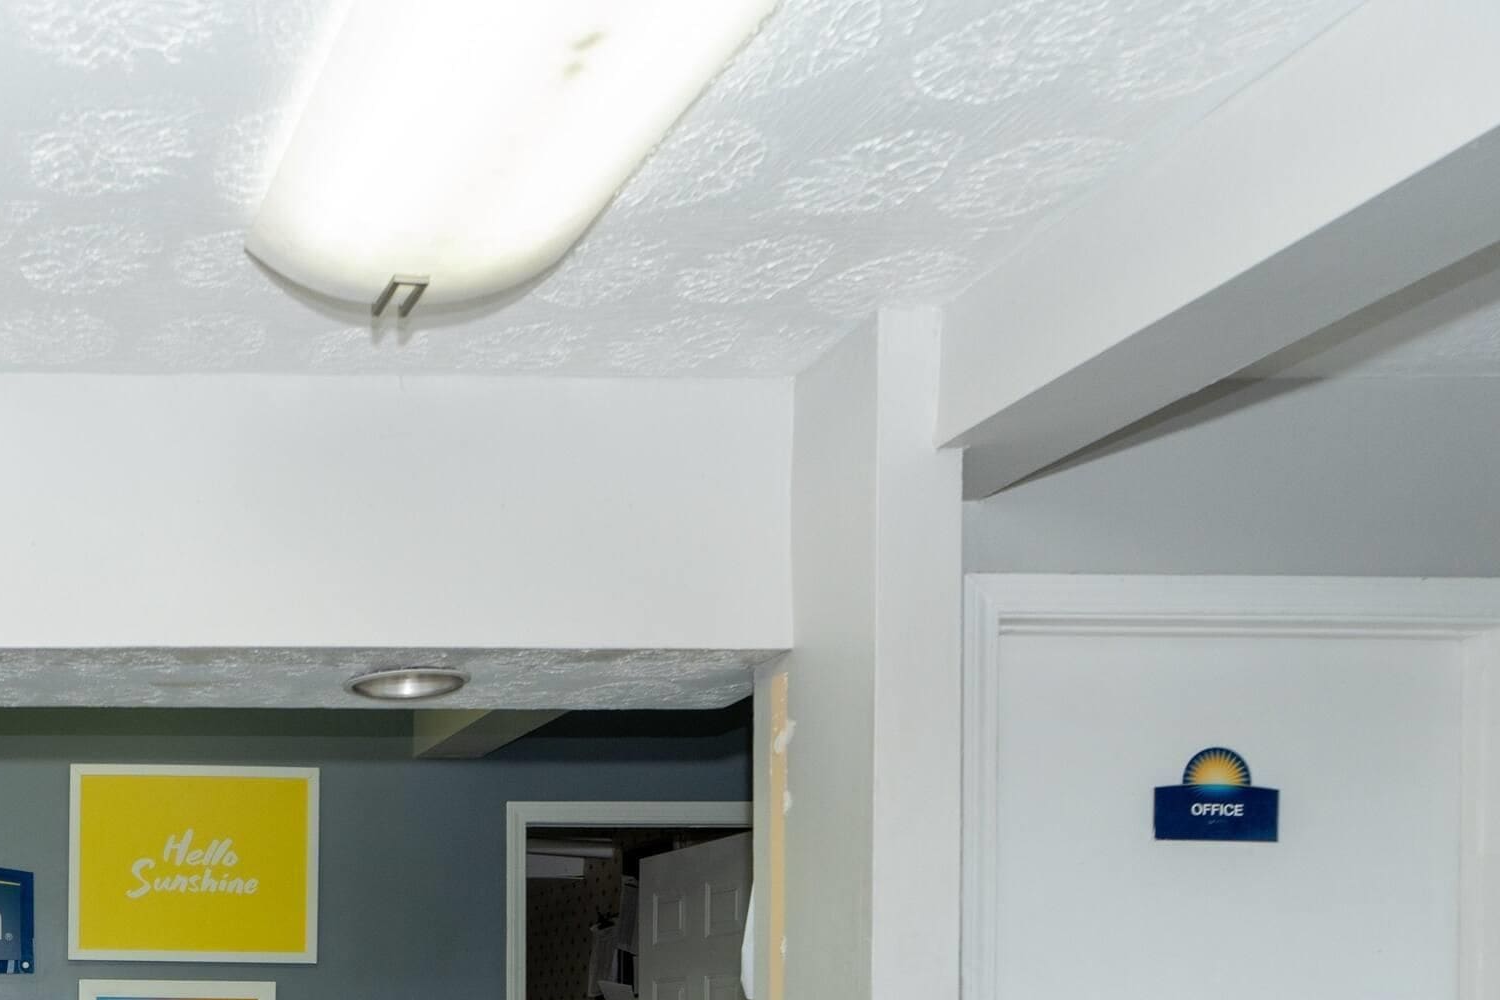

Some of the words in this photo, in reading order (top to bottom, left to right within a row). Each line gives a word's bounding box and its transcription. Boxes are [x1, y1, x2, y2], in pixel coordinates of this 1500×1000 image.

[1191, 802, 1245, 817] OFFICE
[164, 827, 239, 867] Hello
[125, 857, 260, 898] Sunshine
